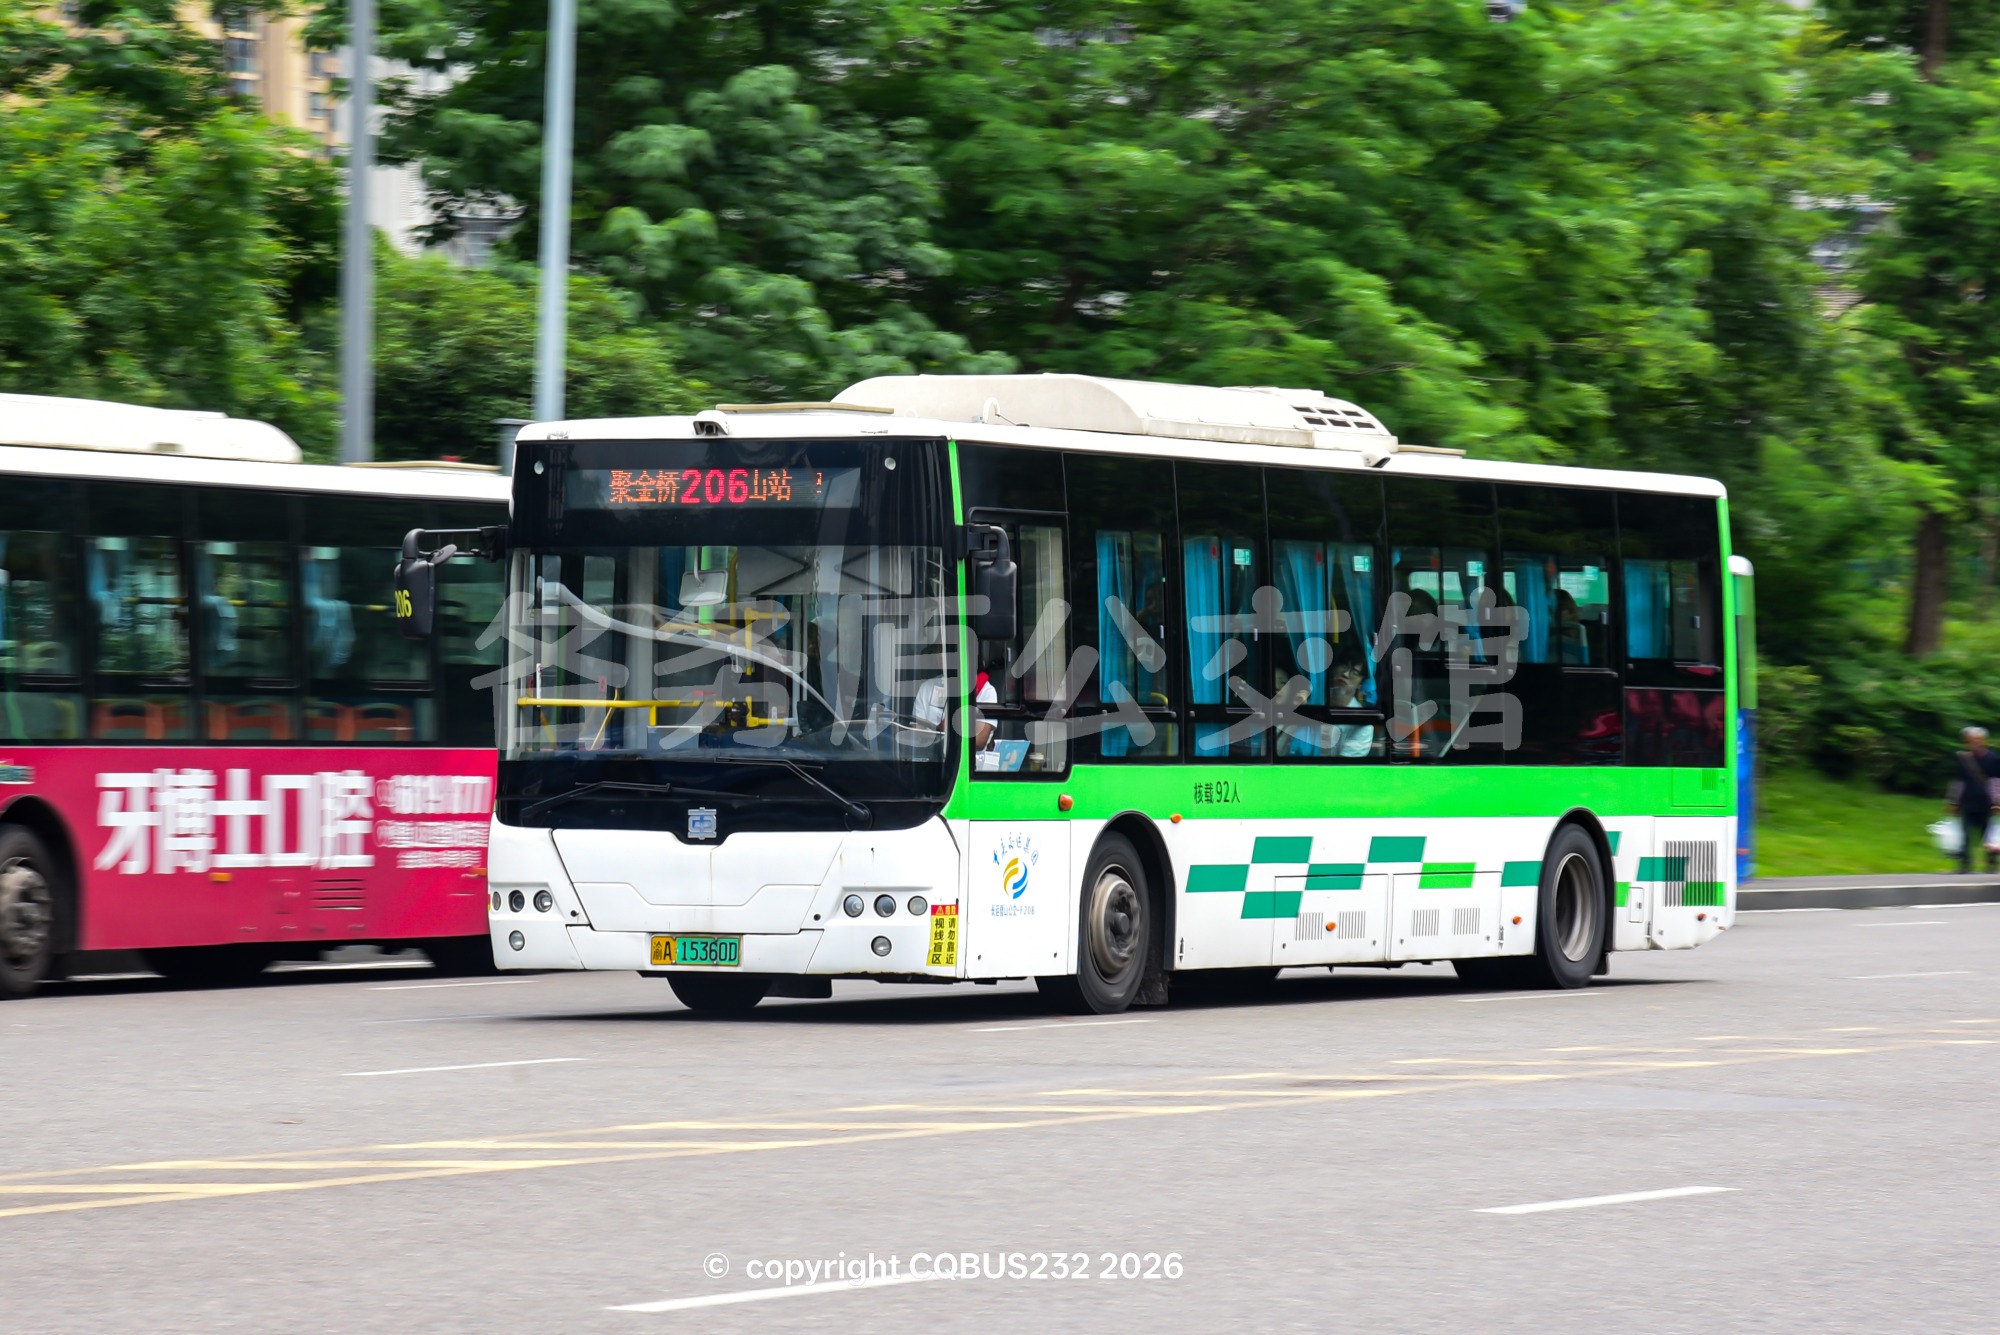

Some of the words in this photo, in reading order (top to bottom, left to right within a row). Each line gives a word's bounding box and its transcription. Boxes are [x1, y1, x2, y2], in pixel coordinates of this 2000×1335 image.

[681, 469, 749, 503] 206
[1193, 781, 1241, 804] 核载92人
[94, 768, 375, 874] 牙博士口腔
[931, 917, 944, 964] 视线盲区
[946, 917, 956, 964] 请勿靠近
